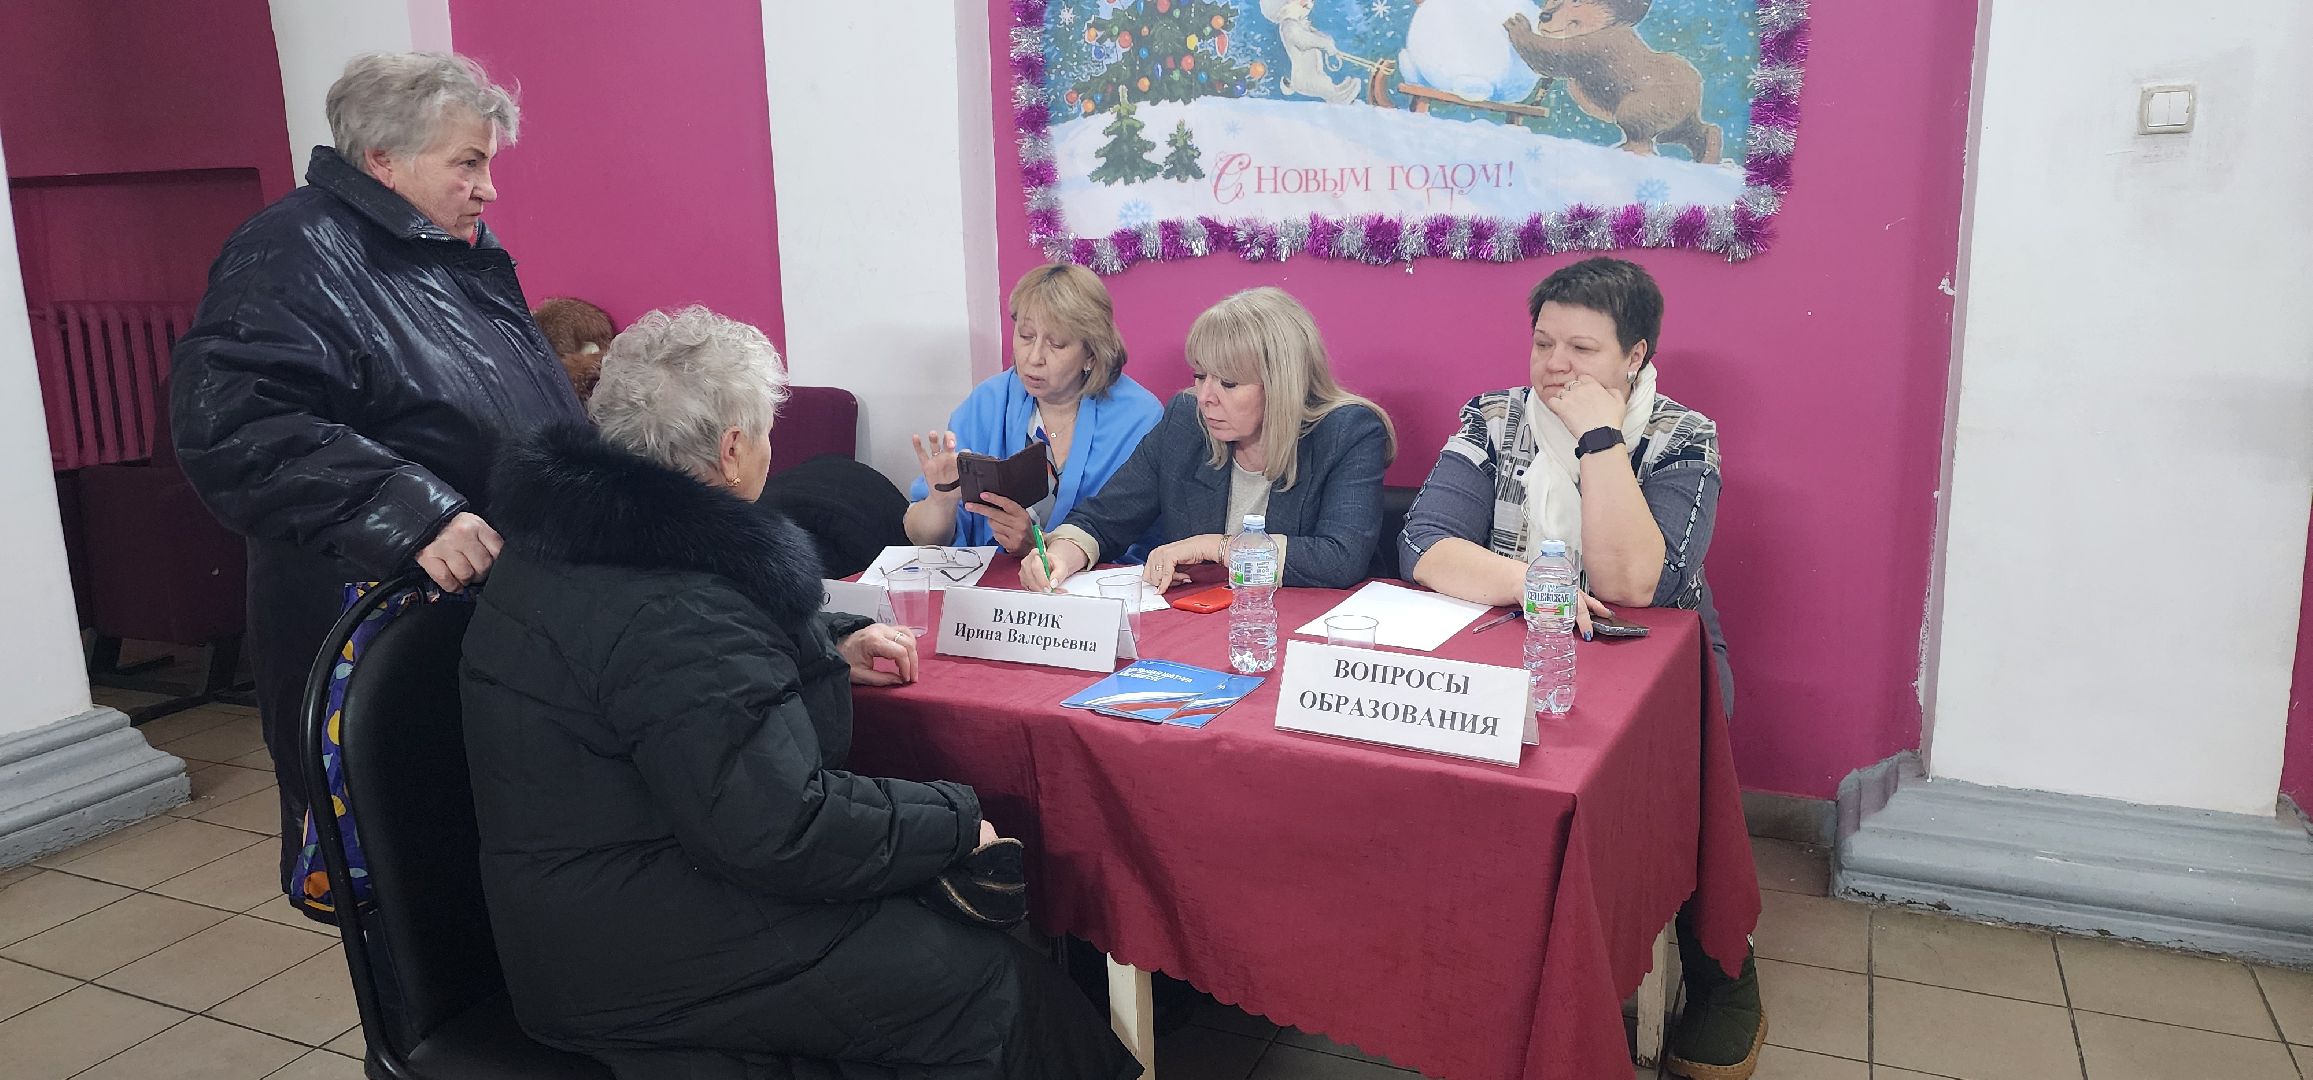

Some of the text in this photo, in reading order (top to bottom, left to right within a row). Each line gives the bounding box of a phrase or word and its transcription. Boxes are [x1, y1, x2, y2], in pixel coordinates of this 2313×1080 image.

[1211, 152, 1251, 204] С
[992, 607, 1063, 629] ВАВРИК
[955, 622, 1097, 652] Ирина Валерьевна
[1334, 658, 1470, 695] ВОПРОСЫ
[1299, 690, 1501, 737] ОБРАЗОВАНИЯ
